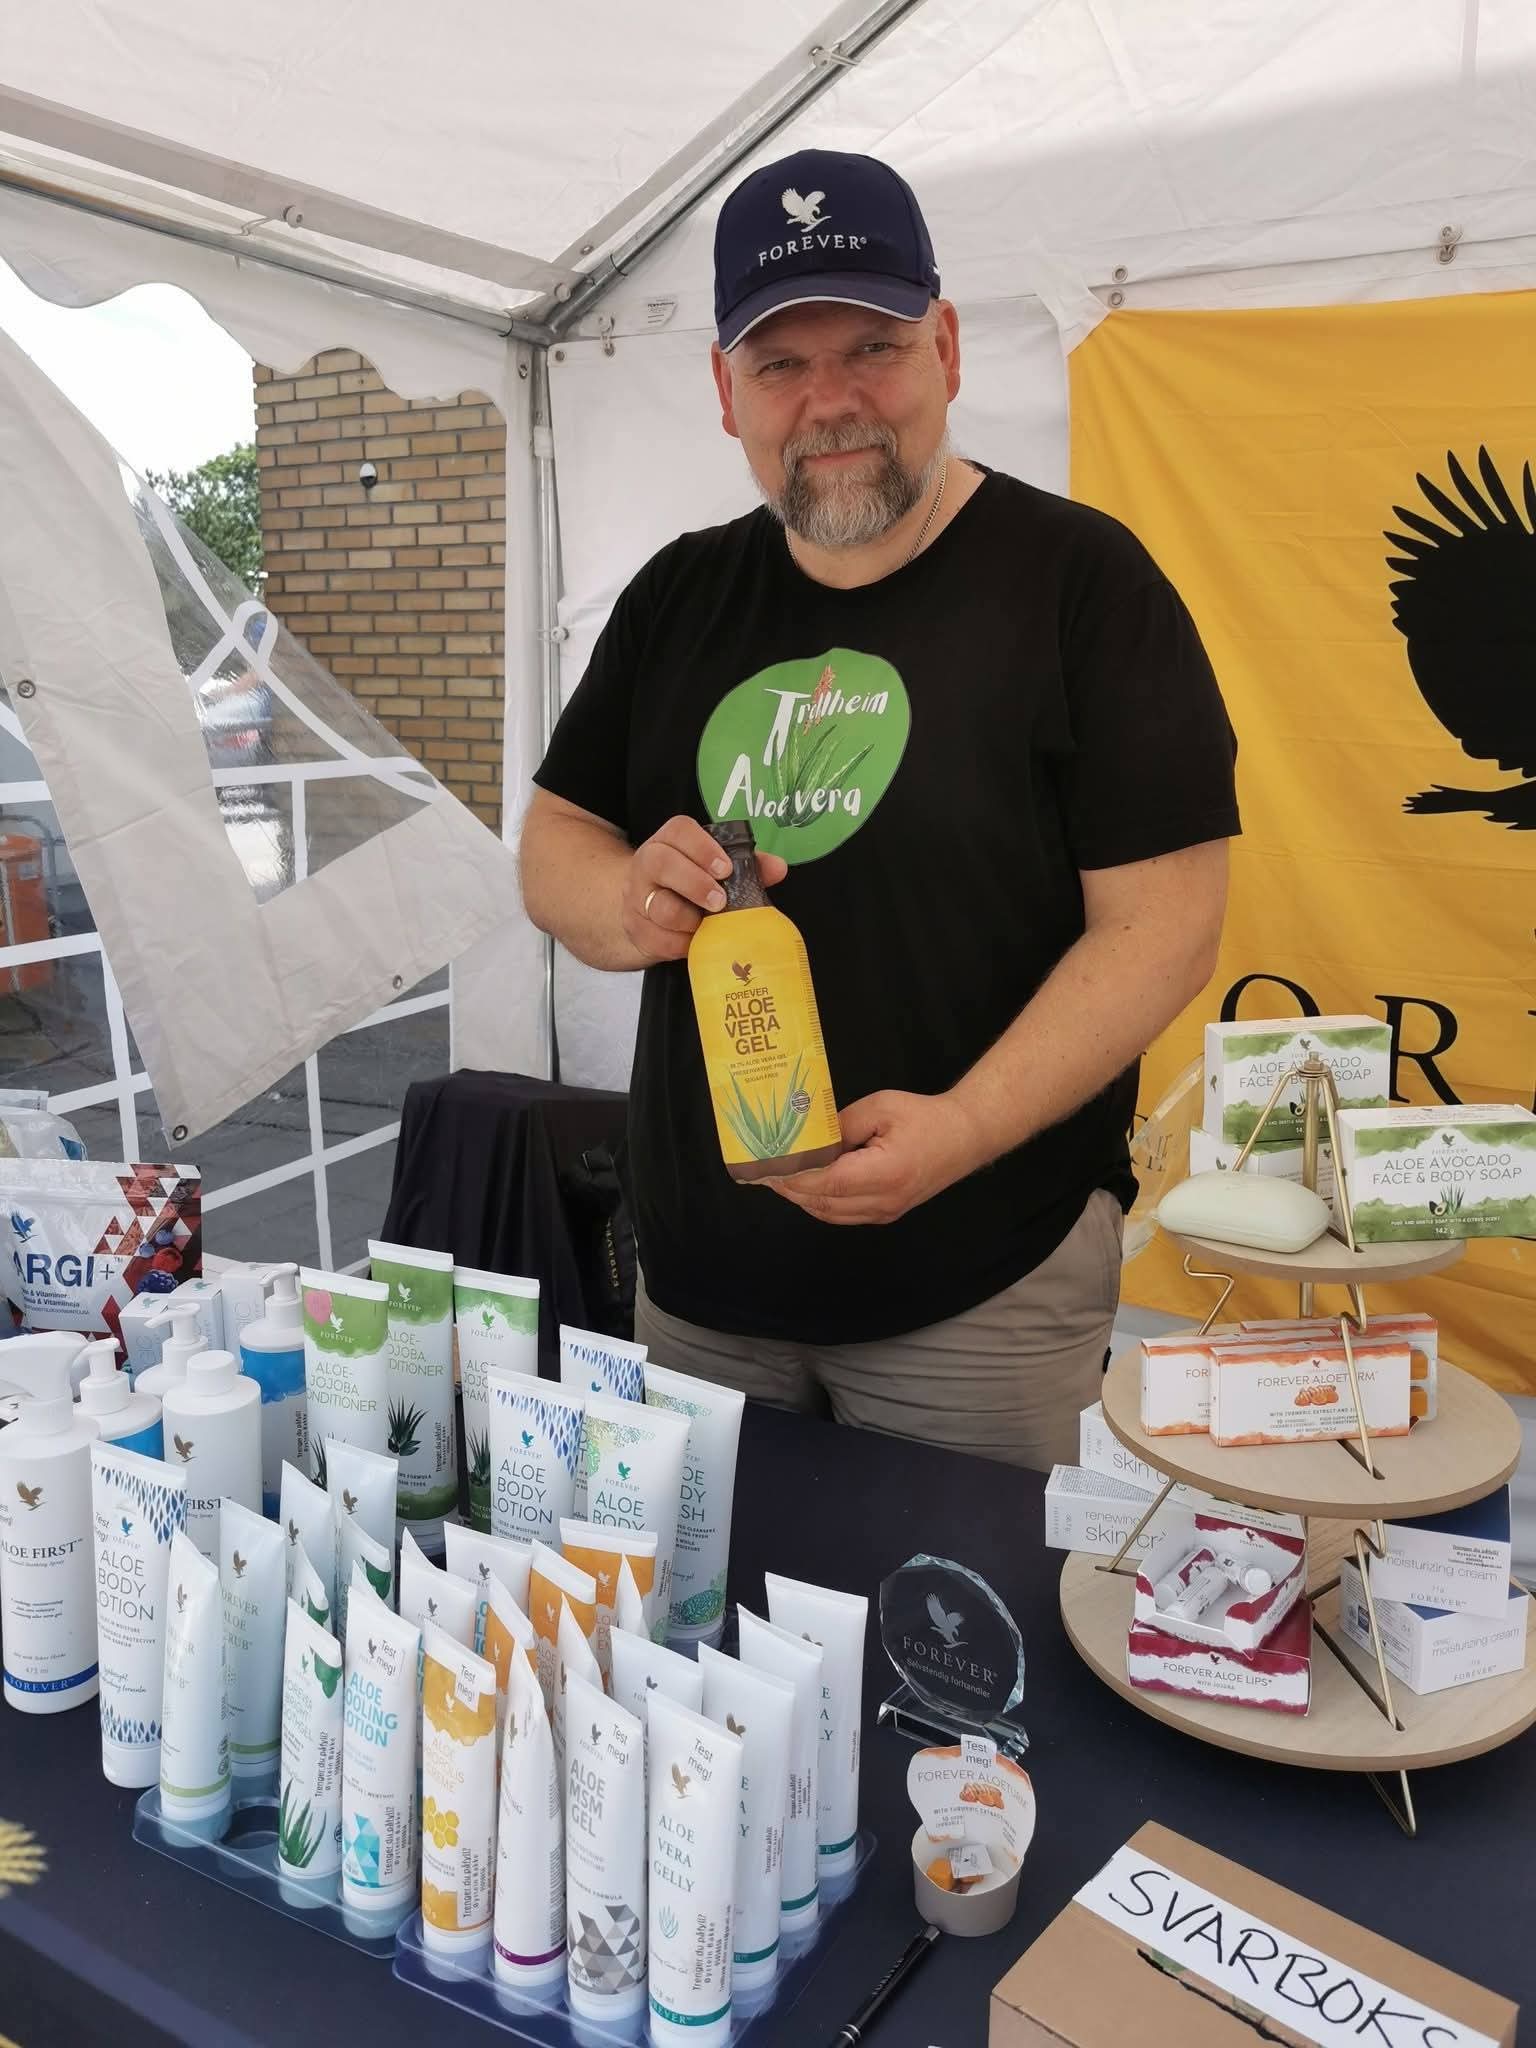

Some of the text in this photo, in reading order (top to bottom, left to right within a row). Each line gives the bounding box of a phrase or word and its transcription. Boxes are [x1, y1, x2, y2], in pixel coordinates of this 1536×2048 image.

[717, 753, 862, 818] Aloe vera
[725, 986, 769, 1001] FOREVER
[724, 996, 777, 1021] ALOE
[724, 1015, 781, 1039] VERA
[735, 1034, 778, 1056] GEL
[1239, 1069, 1372, 1088] FACE SOAP
[1250, 1062, 1284, 1074] ALOE
[1384, 1153, 1512, 1170] ALOE AVOCADO
[1373, 1167, 1522, 1185] FACE & BODY SOAP
[36, 1290, 68, 1299] Vitaminer
[386, 1343, 427, 1363] OJOBA
[389, 1358, 444, 1377] DITIONER
[310, 1374, 360, 1397] JOJOBA
[1257, 1372, 1376, 1388] FOREVER ALOETRM
[305, 1391, 377, 1412] ONDITIONER
[500, 1458, 546, 1484] ALOE
[1112, 1452, 1149, 1479] skin
[497, 1476, 547, 1503] BODY
[679, 1484, 707, 1504] DY
[492, 1491, 553, 1525] LOTION
[595, 1490, 645, 1518] ALOE
[679, 1504, 706, 1523] SH
[1085, 1523, 1128, 1545] skin
[32, 1541, 77, 1559] FIRST
[100, 1549, 145, 1577] ALOE
[1383, 1556, 1454, 1577] moisturizing
[1457, 1568, 1498, 1582] cream
[98, 1567, 146, 1598] BODY
[98, 1590, 155, 1621] OTION
[221, 1589, 260, 1617] OREVER
[1410, 1592, 1462, 1607] FOREVER
[381, 1640, 397, 1659] Test
[1432, 1635, 1488, 1657] moisturizing
[1490, 1628, 1520, 1643] cream
[376, 1655, 396, 1677] meg!
[903, 1636, 995, 1685] FOREVER
[9, 1677, 69, 1692] FOREVER
[461, 1663, 476, 1684] Test
[1163, 1662, 1270, 1687] FOREVER ALOE LIPS
[350, 1671, 383, 1706] ALOE
[457, 1682, 476, 1702] meg!
[345, 1687, 398, 1730] OOLING
[345, 1709, 388, 1748] OTION
[612, 1723, 628, 1745] Test
[608, 1743, 629, 1765] meg!
[694, 1737, 713, 1764] Test
[966, 1740, 988, 1753] Test
[688, 1755, 713, 1782] meg!
[965, 1754, 992, 1769] meg!
[570, 1758, 606, 1800] ALOE
[917, 1769, 975, 1783] FOREVER
[569, 1777, 603, 1821] MSM
[571, 1803, 597, 1839] GEL
[658, 1815, 695, 1845] ALOE
[657, 1836, 693, 1869] VERA
[653, 1859, 696, 1893] GELLY
[692, 1958, 705, 1991] Trenger
